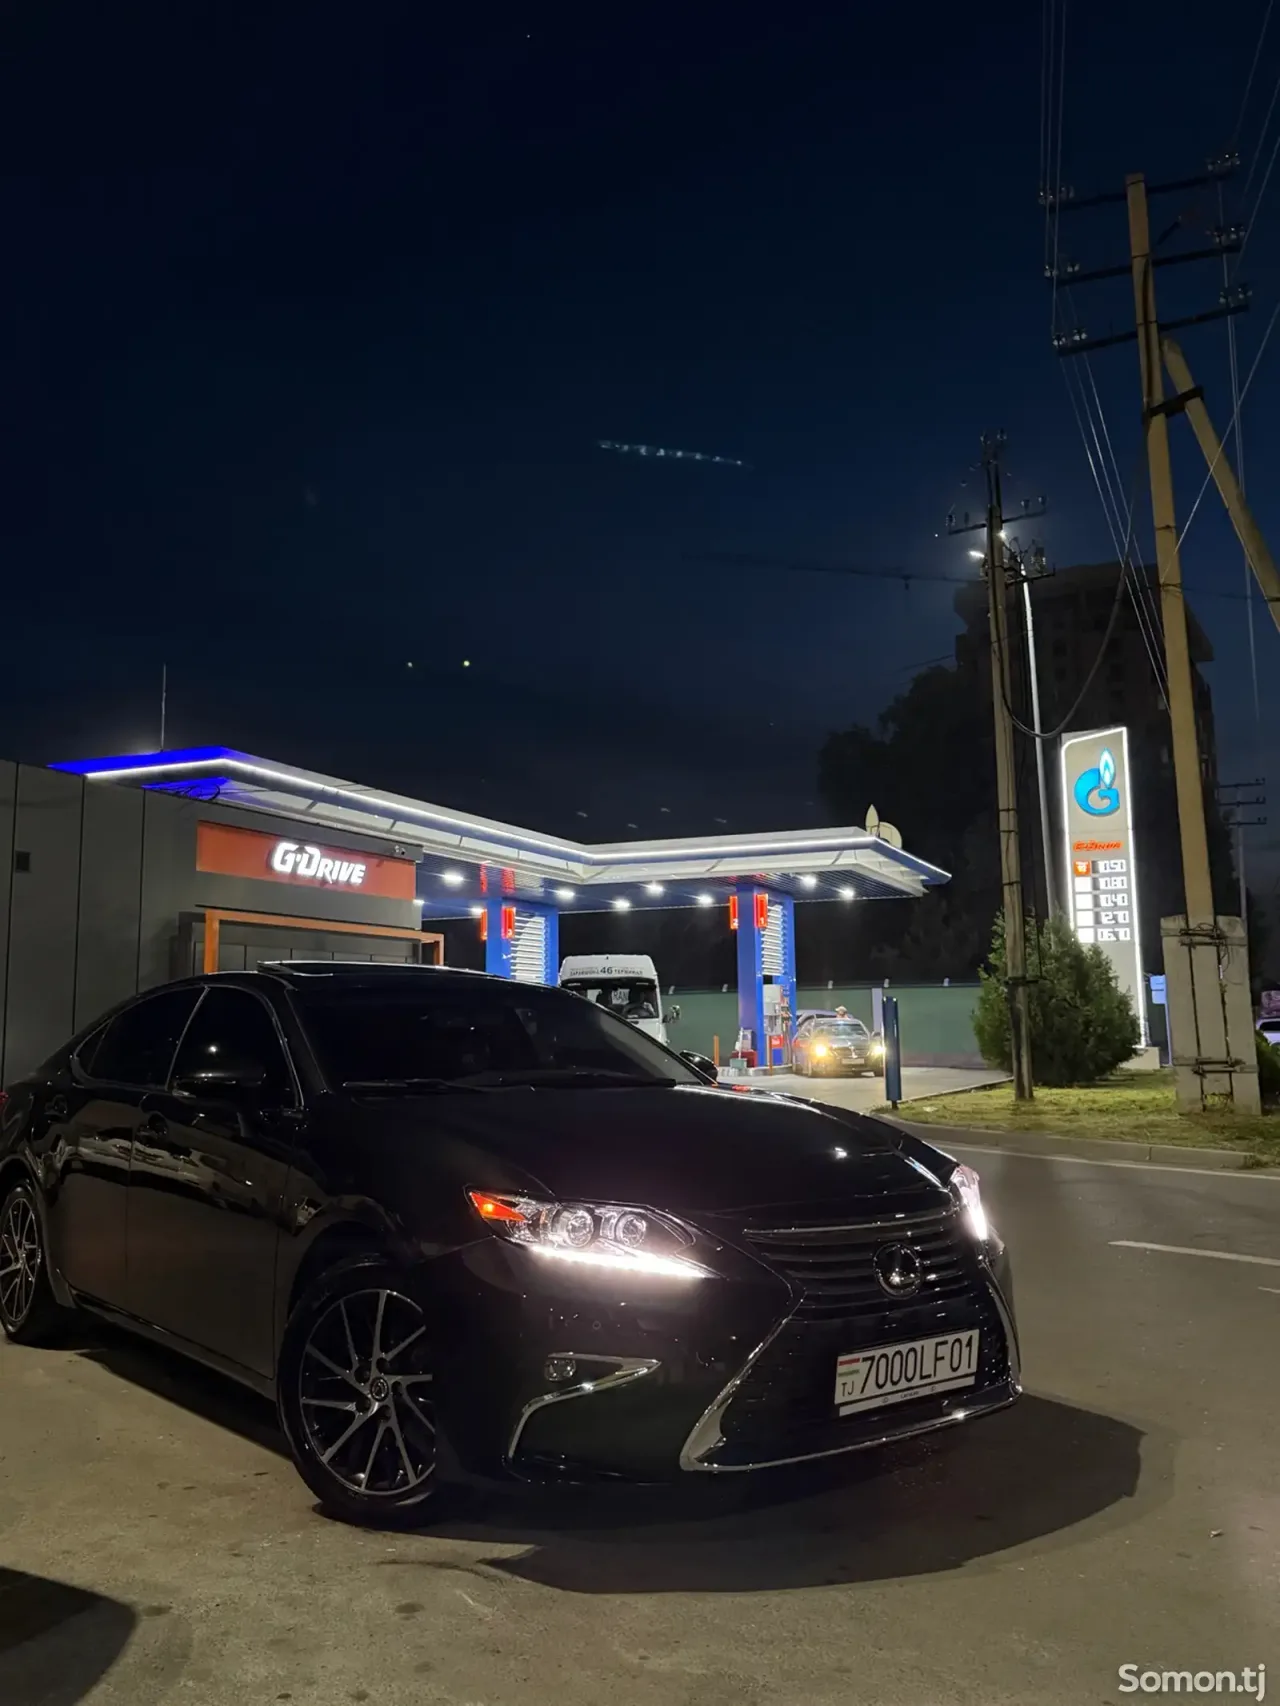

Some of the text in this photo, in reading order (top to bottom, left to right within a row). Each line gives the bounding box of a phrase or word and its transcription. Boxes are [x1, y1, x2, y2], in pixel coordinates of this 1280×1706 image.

[600, 967, 613, 975] 46
[860, 1335, 973, 1395] 7000LF01
[841, 1381, 854, 1397] TJ
